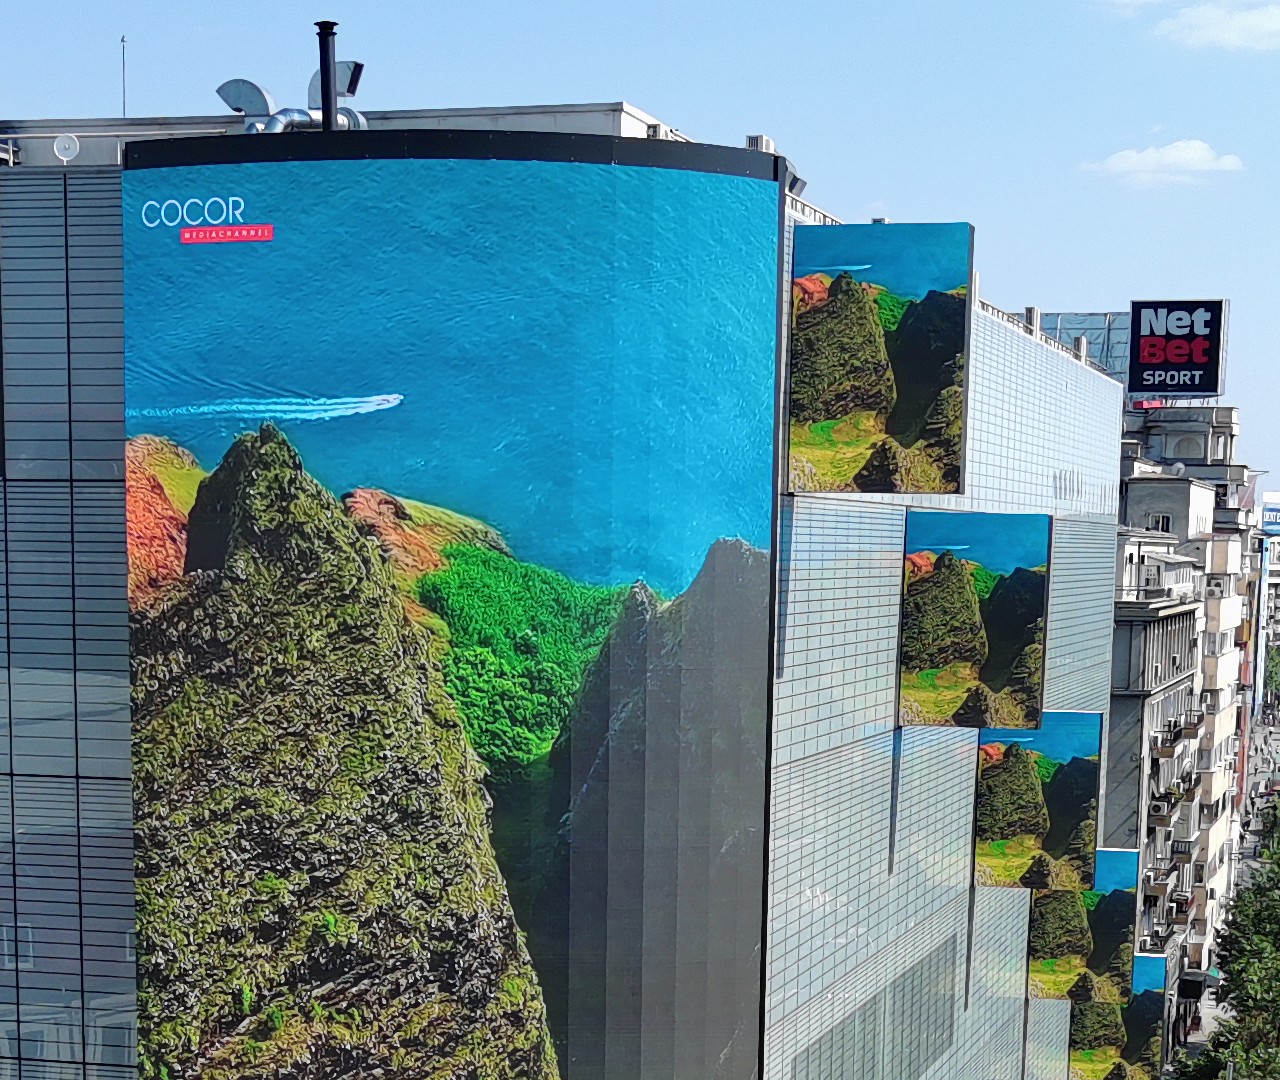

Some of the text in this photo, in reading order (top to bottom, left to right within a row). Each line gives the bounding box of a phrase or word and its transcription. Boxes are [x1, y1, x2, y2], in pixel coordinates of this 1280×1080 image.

[141, 196, 245, 228] COCOR
[183, 228, 270, 240] MEDIACHANNEL
[1139, 307, 1212, 336] Net
[1138, 336, 1211, 364] Bet
[1142, 370, 1204, 385] SPORT
